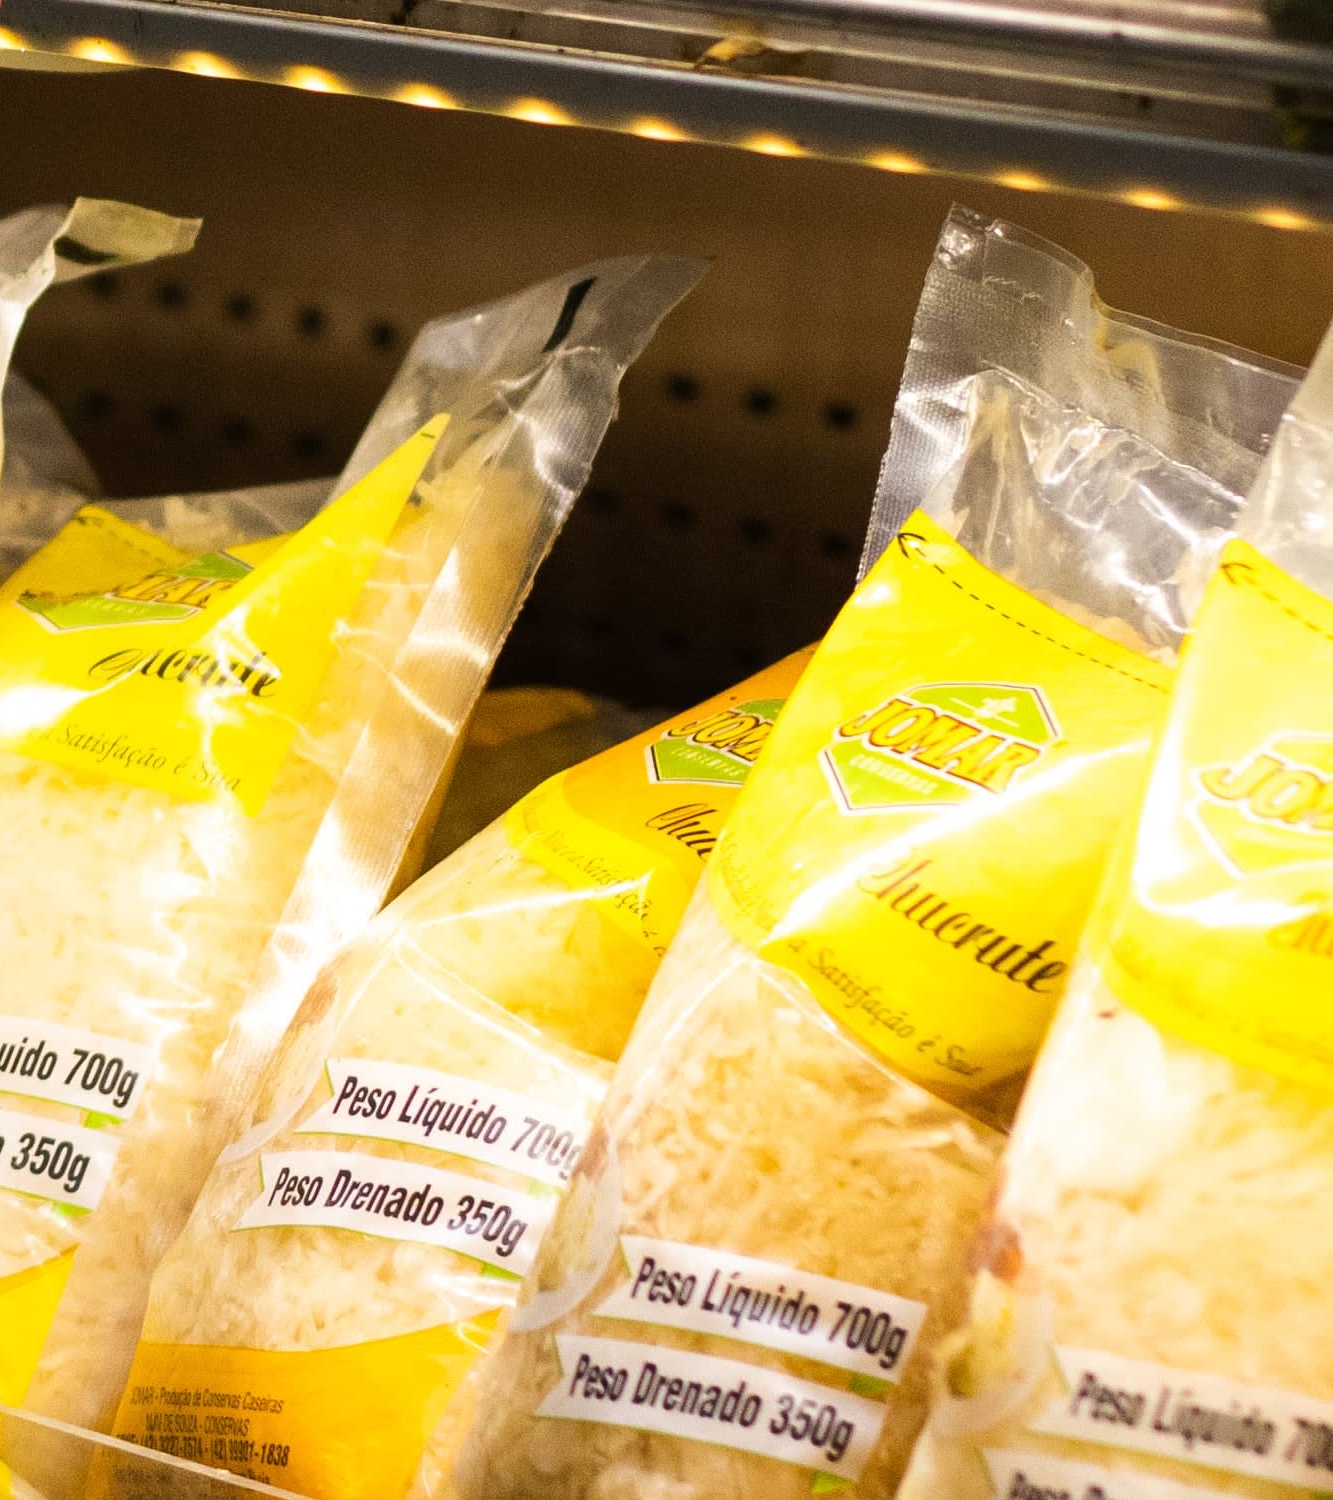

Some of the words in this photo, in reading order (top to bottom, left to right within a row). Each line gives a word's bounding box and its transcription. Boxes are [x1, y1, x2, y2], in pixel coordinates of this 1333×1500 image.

[60, 722, 168, 773] Satisfação
[838, 697, 1042, 795] JOMAR
[808, 946, 919, 1041] Satisfação
[64, 1048, 140, 1109] 700g
[11, 1132, 91, 1194] 350g
[332, 1075, 398, 1120] Peso
[397, 1084, 508, 1145] Líquido
[509, 1116, 583, 1180] 700g
[267, 1167, 325, 1208] Peso
[323, 1168, 445, 1227] Drenado
[447, 1194, 529, 1258] 350g
[630, 1256, 697, 1307] Peso
[700, 1269, 821, 1336] Líquido
[827, 1300, 908, 1370] 700g
[242, 1391, 285, 1415] Caseiras
[568, 1353, 628, 1402] Peso
[631, 1362, 764, 1429] Drenado
[769, 1393, 856, 1463] 350g
[1068, 1371, 1146, 1428] Peso
[1152, 1384, 1277, 1456] Líquido
